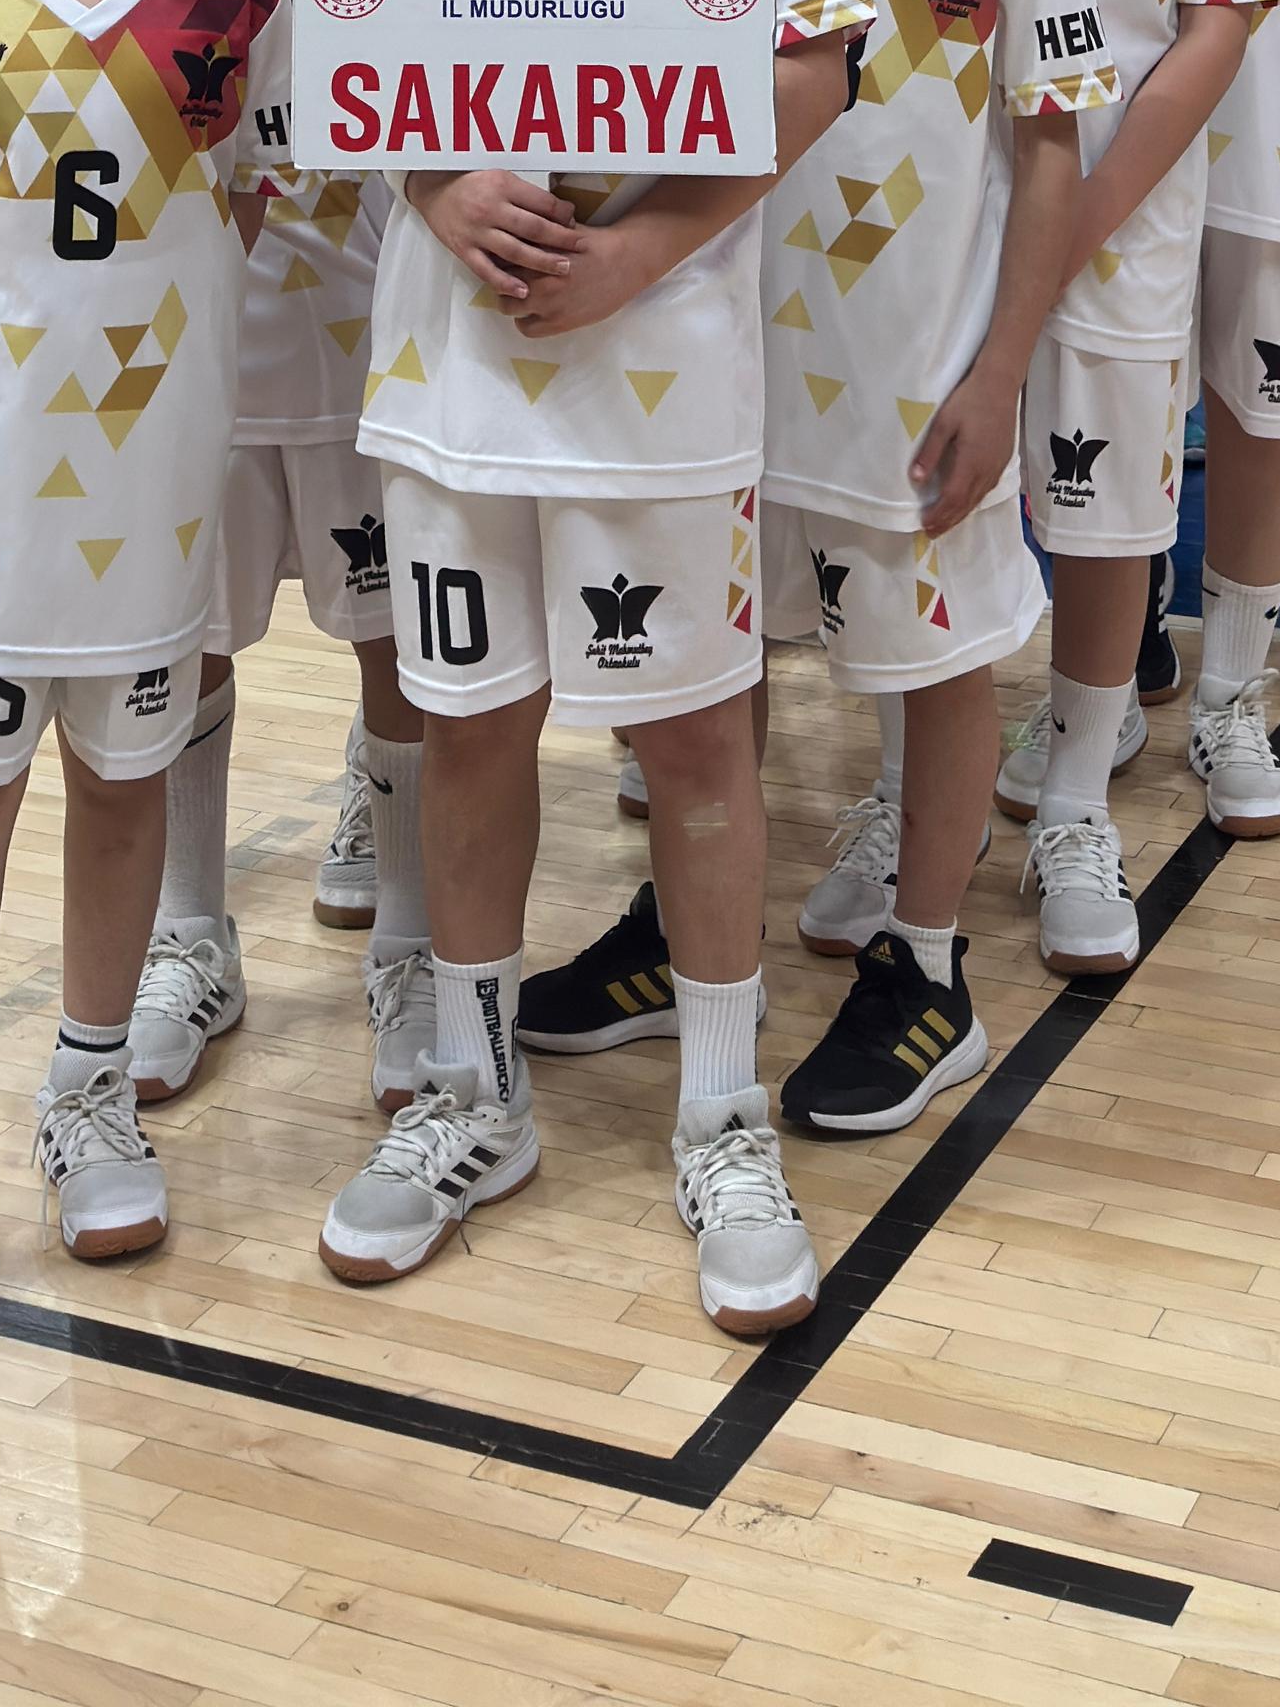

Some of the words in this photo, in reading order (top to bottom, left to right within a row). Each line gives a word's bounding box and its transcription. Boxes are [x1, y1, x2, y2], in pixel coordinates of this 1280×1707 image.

[329, 62, 737, 155] SAKARYA
[52, 149, 119, 260] 6
[411, 560, 489, 666] 10
